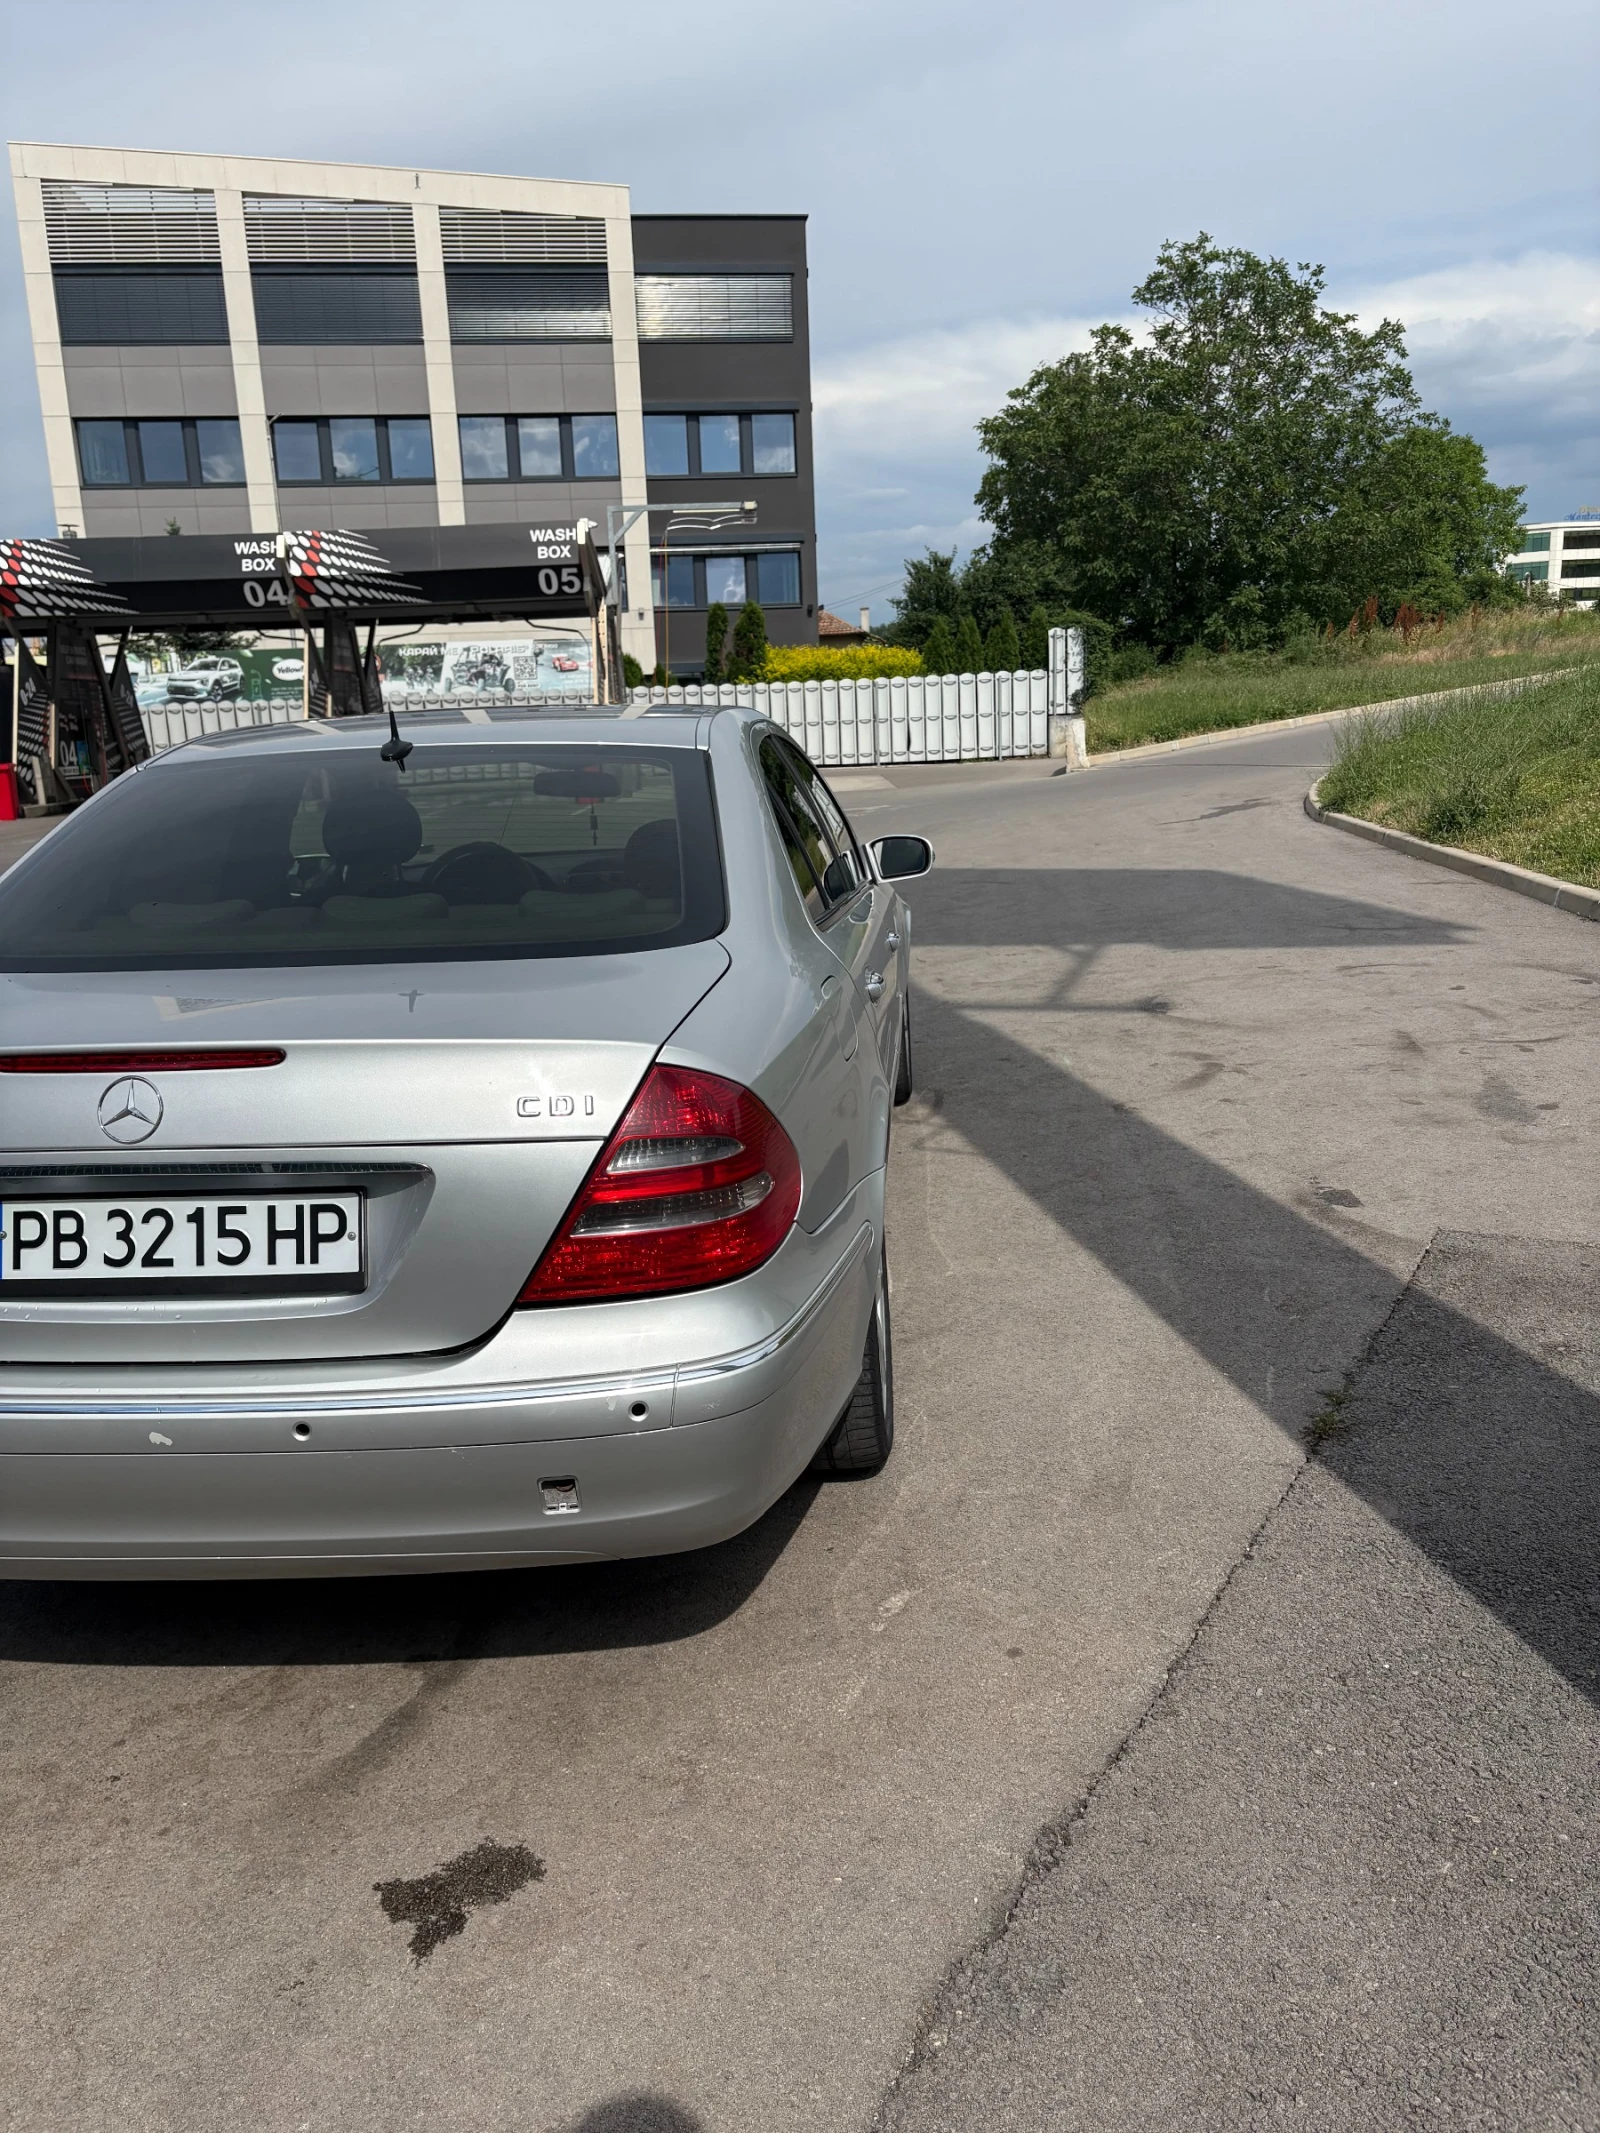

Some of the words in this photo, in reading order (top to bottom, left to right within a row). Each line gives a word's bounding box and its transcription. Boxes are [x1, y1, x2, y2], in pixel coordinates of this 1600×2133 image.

[530, 528, 577, 542] WASH
[234, 541, 277, 555] WASH
[537, 545, 571, 559] BOX
[241, 558, 276, 572] BOX
[538, 567, 582, 595] 05
[243, 579, 289, 608] 04
[398, 645, 438, 657] КАРАЙ
[59, 740, 78, 766] 04
[516, 1095, 594, 1118] CDI
[12, 1209, 88, 1270] PB
[103, 1206, 252, 1268] 3215
[267, 1203, 348, 1266] HP
